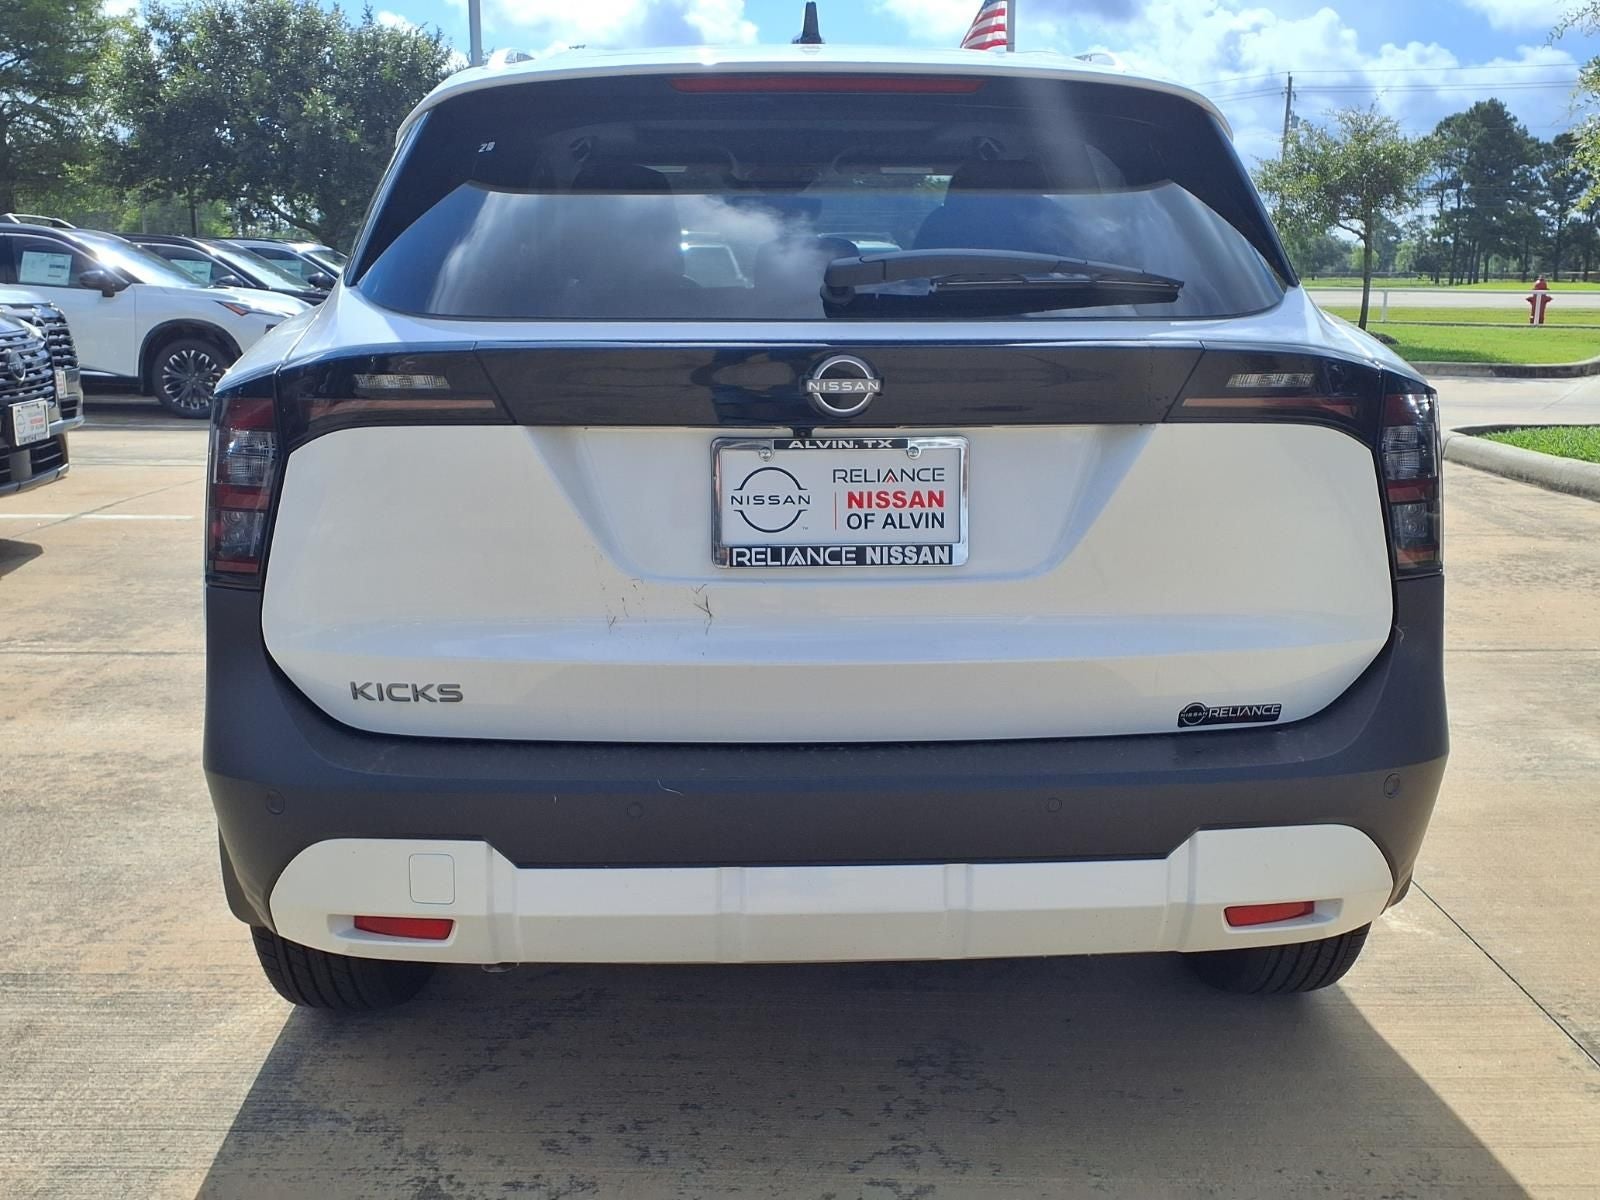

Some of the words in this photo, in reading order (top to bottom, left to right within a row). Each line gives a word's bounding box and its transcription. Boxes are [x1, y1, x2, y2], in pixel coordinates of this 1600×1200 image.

[808, 381, 879, 391] NISSAN
[863, 440, 893, 448] TX
[833, 468, 945, 483] RELIANCE
[731, 495, 811, 505] NISSAN
[847, 490, 945, 509] NISSAN
[846, 512, 876, 530] OF
[882, 512, 945, 529] ALVIN
[732, 546, 857, 566] RELIANCE
[865, 546, 950, 565] NISSAN
[350, 681, 464, 703] KICKS
[1208, 704, 1281, 718] RELIANCE
